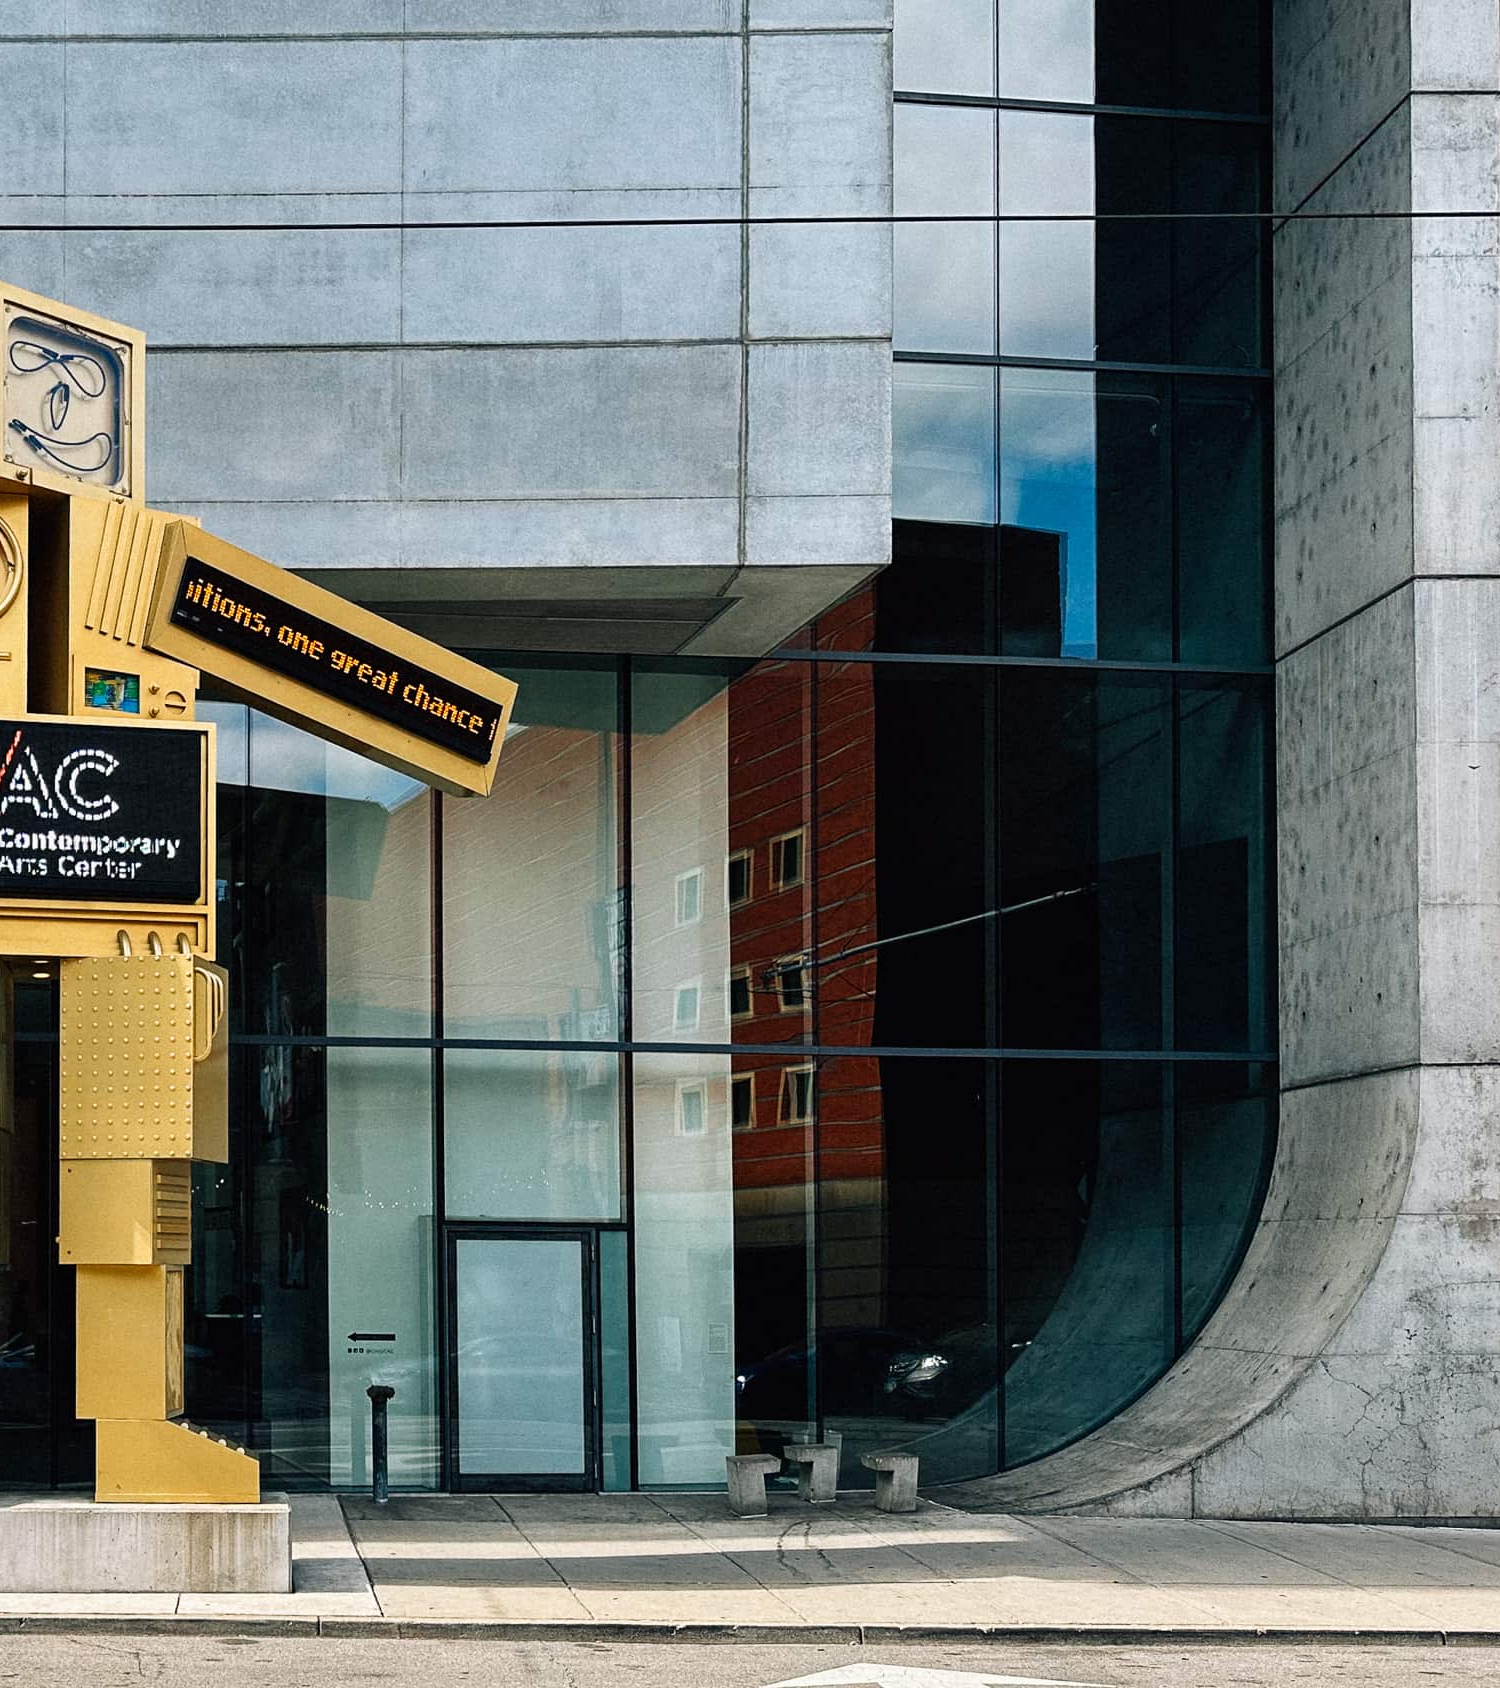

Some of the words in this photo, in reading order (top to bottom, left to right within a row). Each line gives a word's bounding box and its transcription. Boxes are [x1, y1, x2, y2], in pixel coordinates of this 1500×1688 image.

[277, 625, 325, 661] one
[331, 650, 399, 696] great
[403, 683, 484, 735] chance
[58, 855, 142, 879] Center
